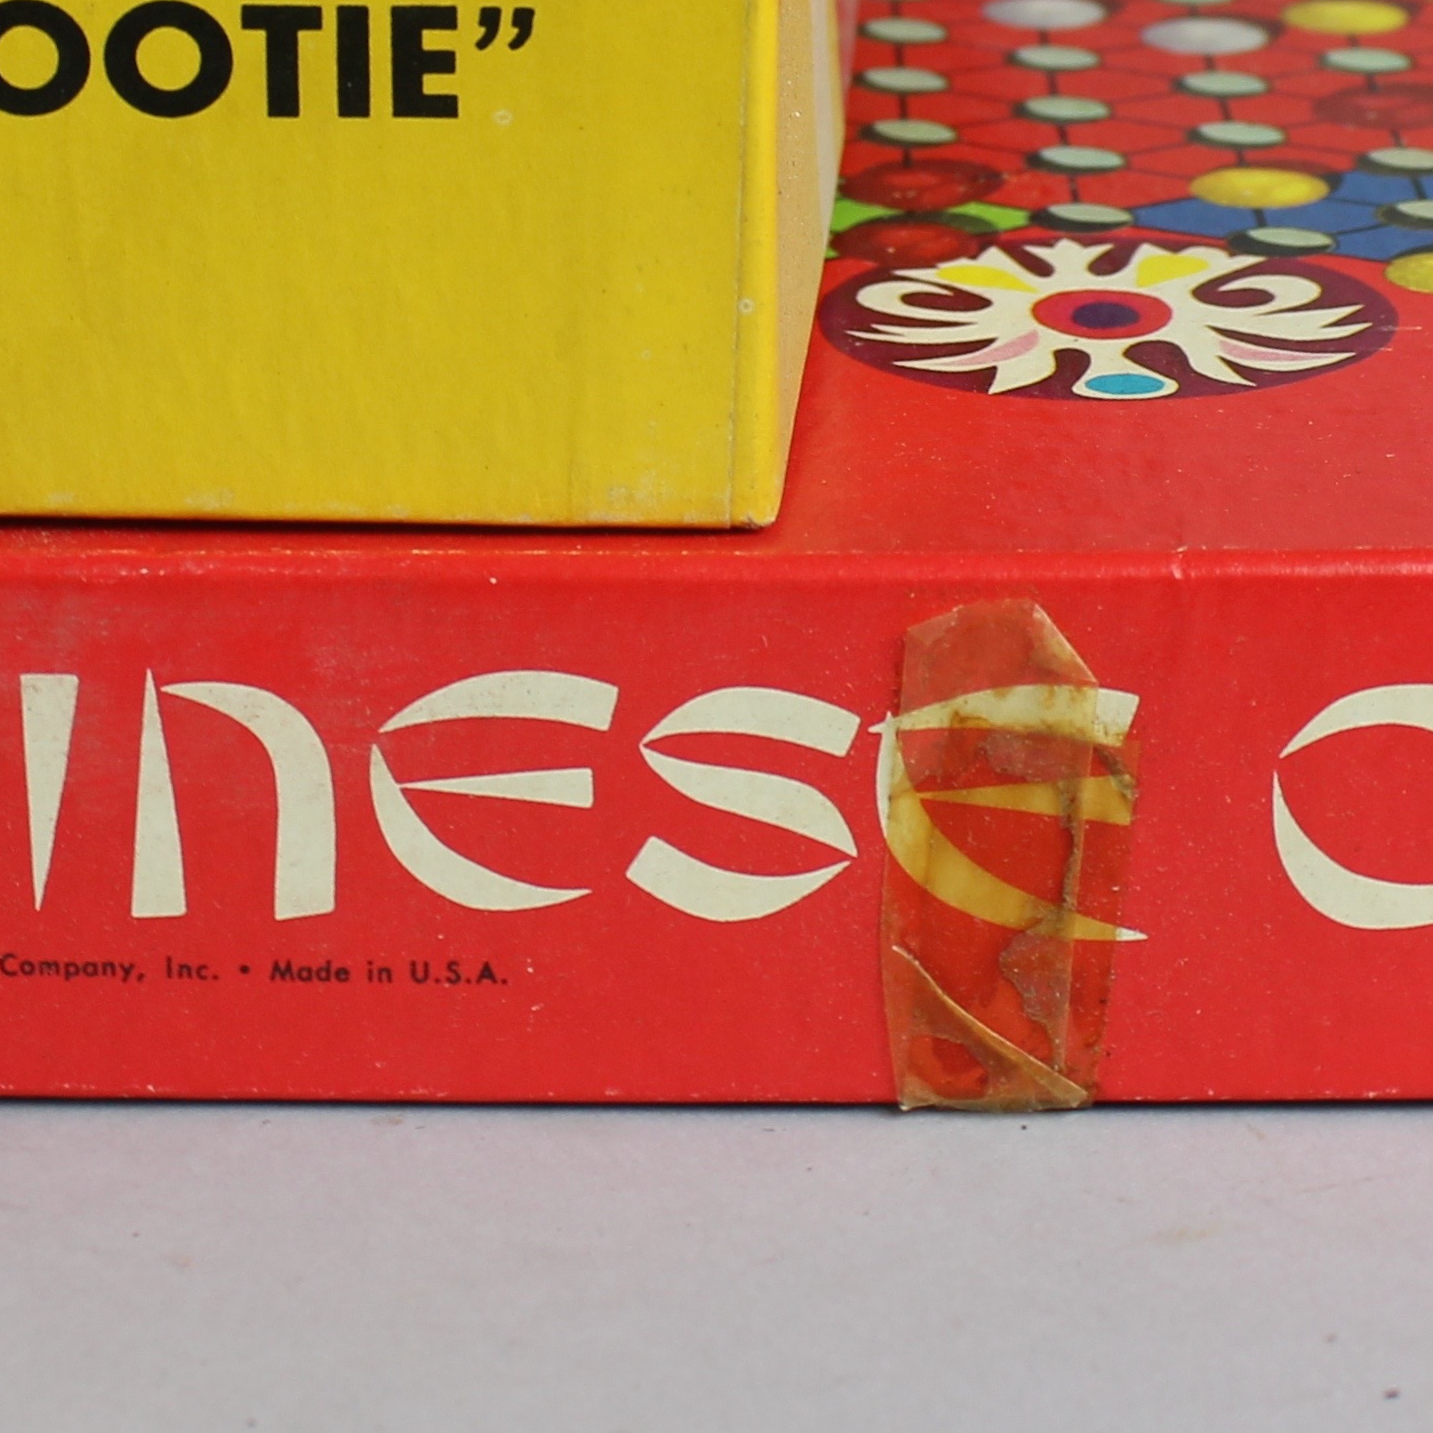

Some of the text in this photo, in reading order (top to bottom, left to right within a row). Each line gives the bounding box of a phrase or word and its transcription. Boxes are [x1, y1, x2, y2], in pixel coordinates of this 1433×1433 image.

[166, 956, 220, 981] Inc.
[270, 959, 352, 983] Made
[367, 959, 394, 983] in
[410, 960, 509, 985] U.S.A.
